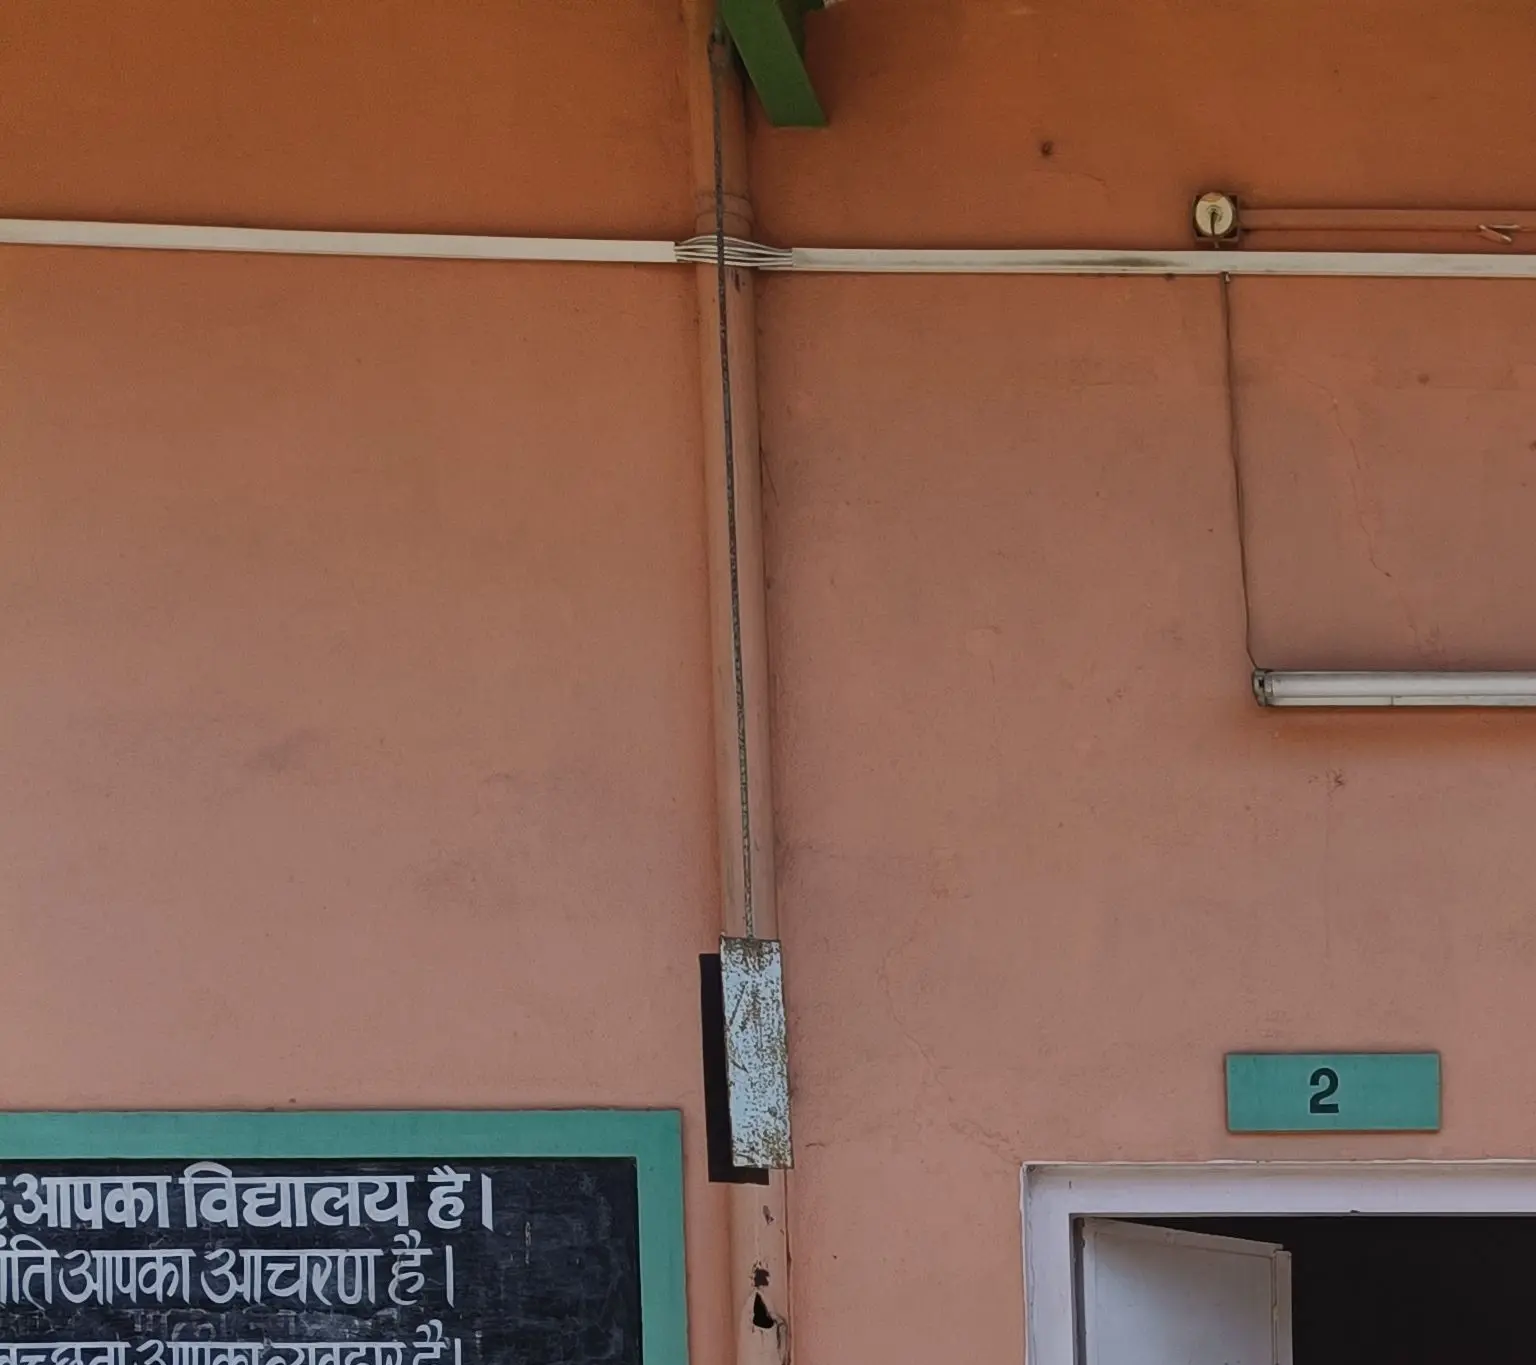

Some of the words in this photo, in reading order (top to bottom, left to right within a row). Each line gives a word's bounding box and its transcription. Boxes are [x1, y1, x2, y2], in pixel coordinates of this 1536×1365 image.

[1308, 1067, 1340, 1113] 2
[13, 1173, 172, 1229] आपका
[179, 1161, 414, 1229] विद्यालय
[59, 1248, 196, 1305] आपका
[201, 1248, 384, 1306] आचरण
